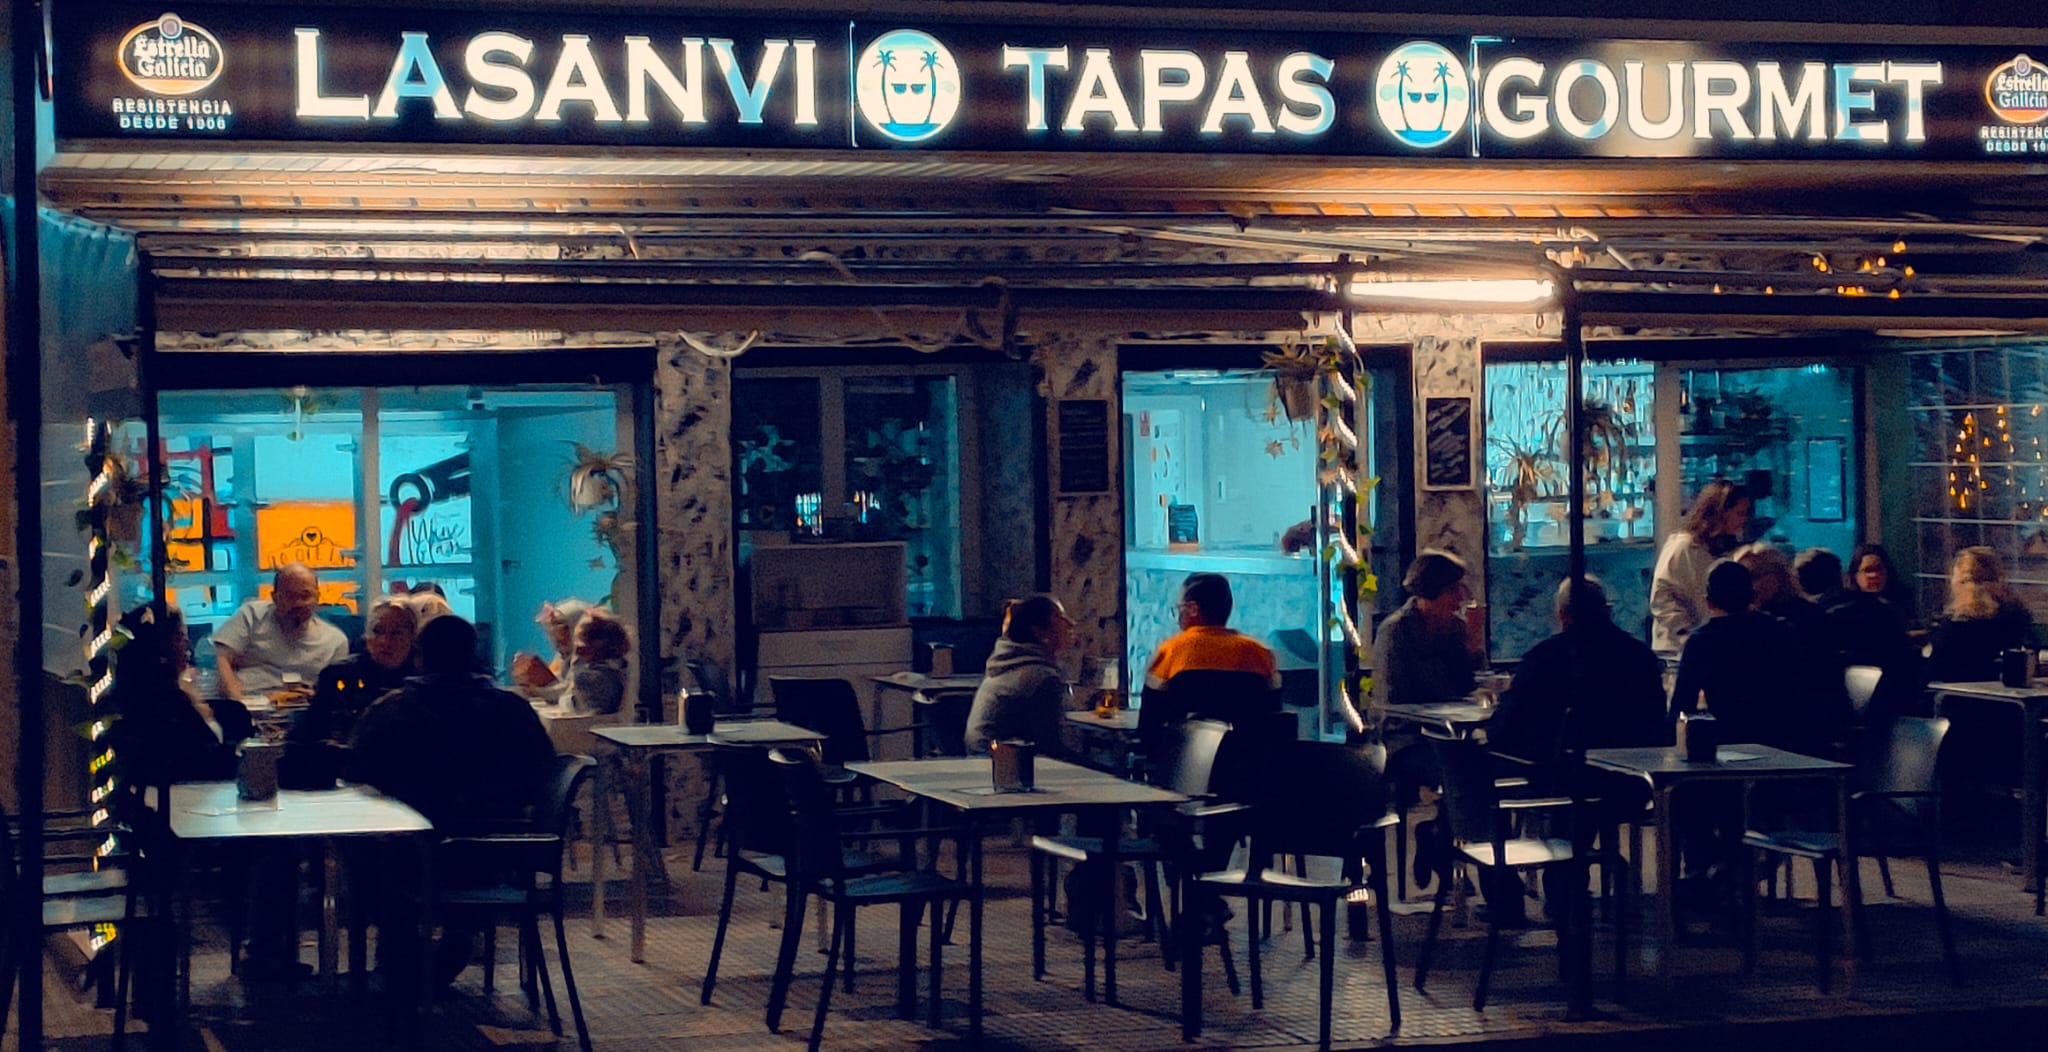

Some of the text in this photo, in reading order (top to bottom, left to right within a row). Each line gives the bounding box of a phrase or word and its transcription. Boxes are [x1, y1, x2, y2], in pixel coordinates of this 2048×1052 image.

[133, 34, 211, 58] Estrella
[137, 57, 208, 77] Galicia
[293, 27, 820, 128] LASANVI
[1002, 43, 1337, 136] TAPAS
[1482, 57, 1944, 143] GOURMET
[112, 97, 232, 115] RESISTENCIA
[120, 114, 178, 129] DESDE
